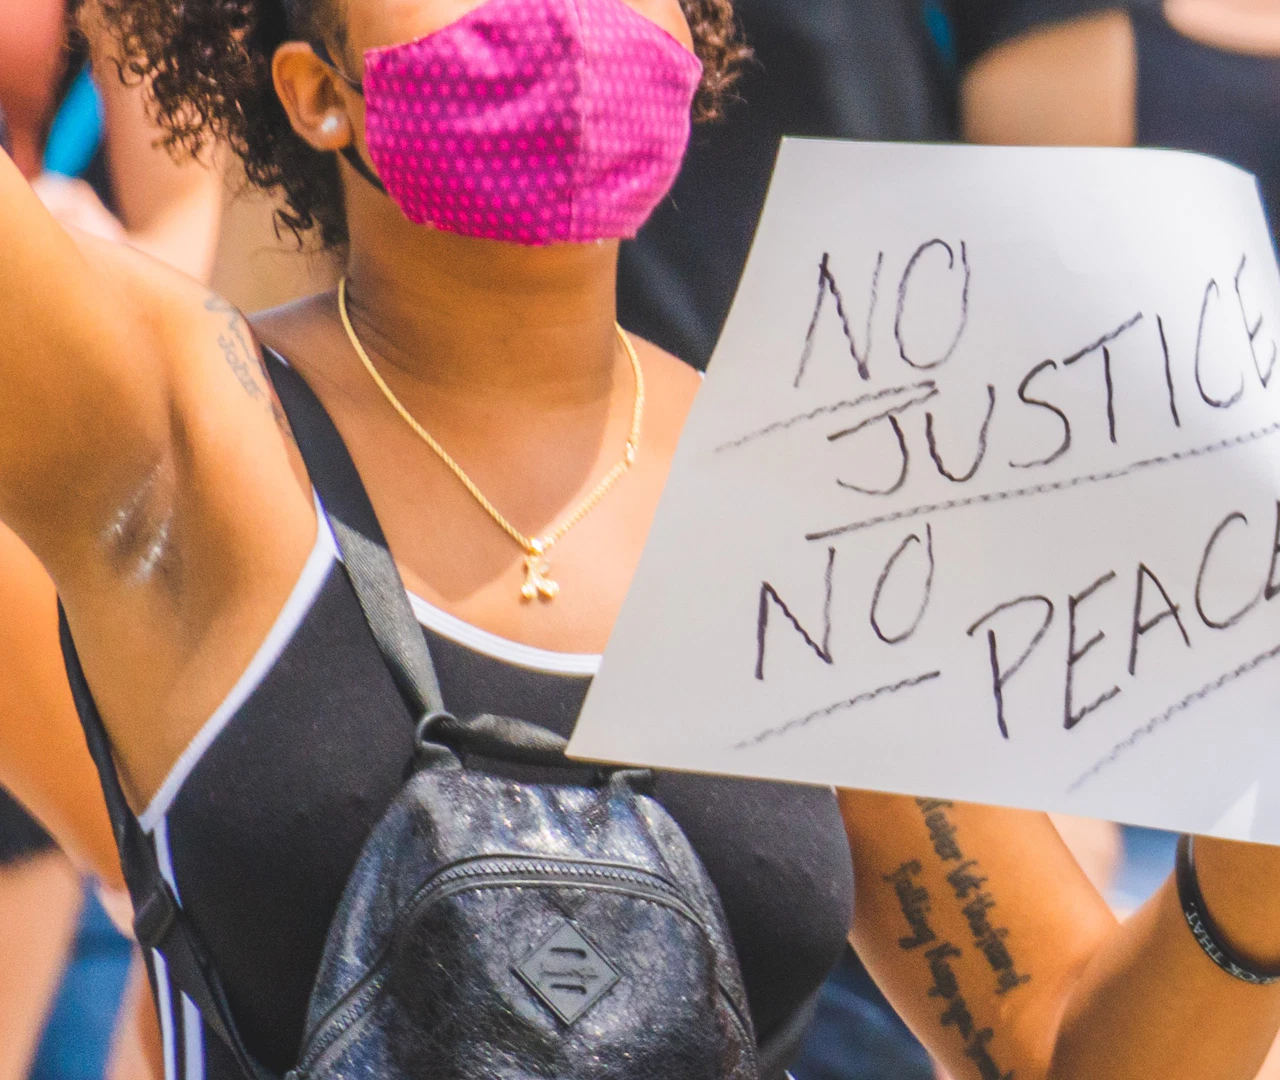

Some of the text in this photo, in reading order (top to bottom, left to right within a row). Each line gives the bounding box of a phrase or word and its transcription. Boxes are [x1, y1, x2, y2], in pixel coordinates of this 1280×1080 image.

[793, 237, 970, 387] NO
[828, 253, 1277, 496] JUSTICE
[756, 522, 936, 680] NO
